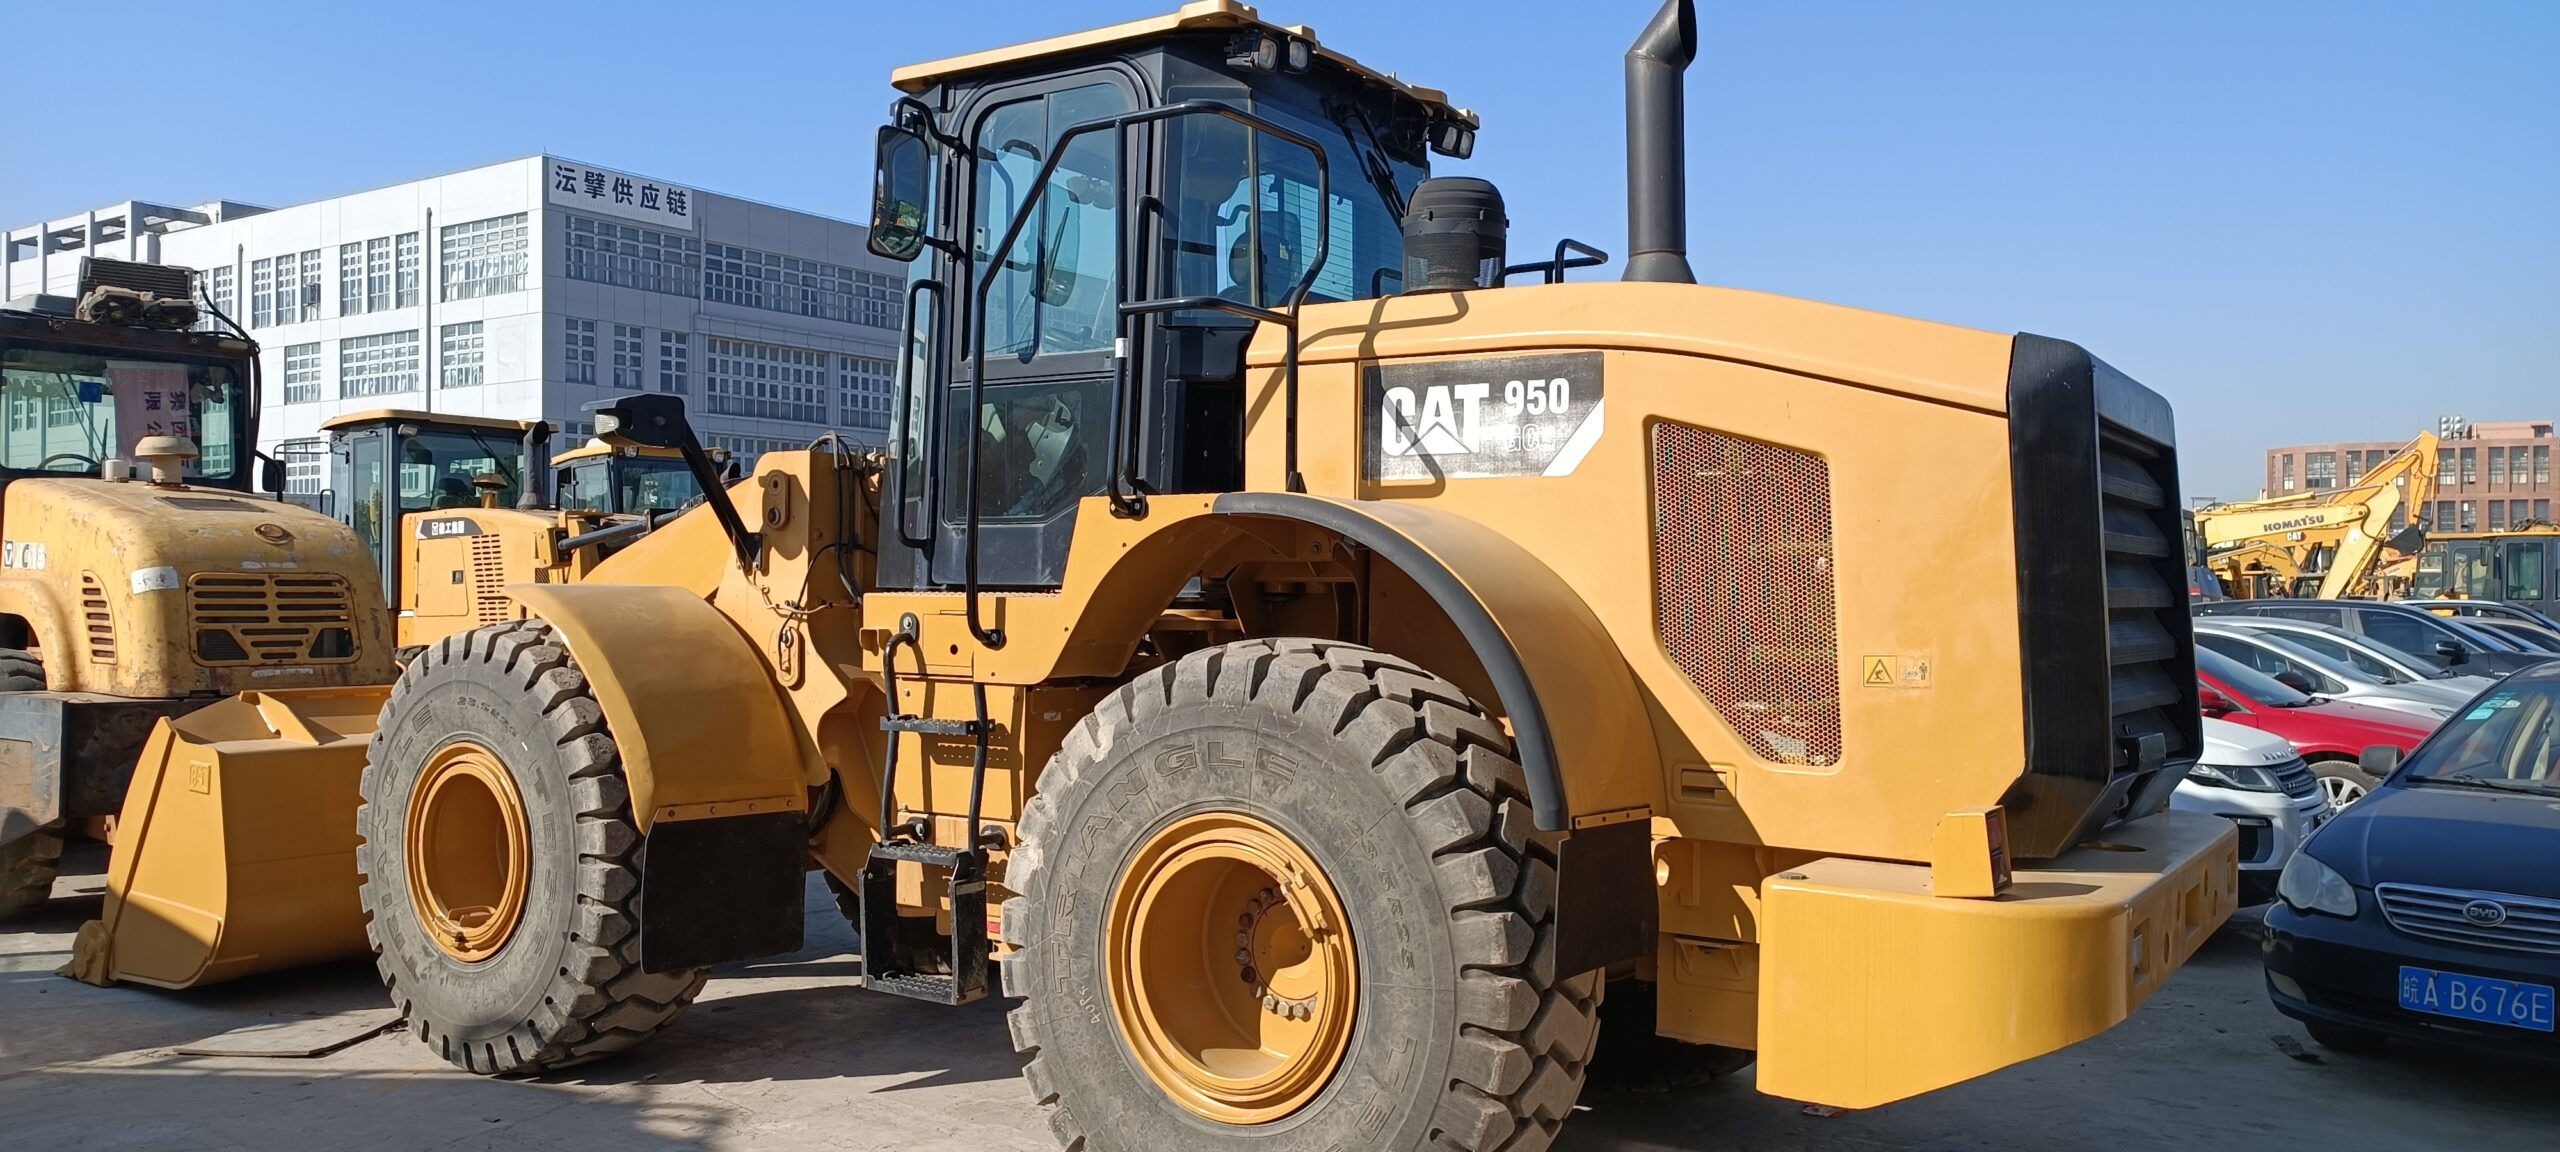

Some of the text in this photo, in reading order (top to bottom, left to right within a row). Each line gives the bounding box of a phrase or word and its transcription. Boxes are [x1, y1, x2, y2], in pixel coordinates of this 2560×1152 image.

[555, 164, 687, 217] 沄擘供应链
[1504, 377, 1570, 416] 950
[1381, 383, 1490, 457] CAT
[2263, 515, 2325, 532] KOMATSU
[2287, 532, 2302, 541] CAT
[375, 703, 432, 983] TRIANGLE
[1052, 740, 1299, 994] TRIANGLE
[2469, 906, 2499, 919] BYD
